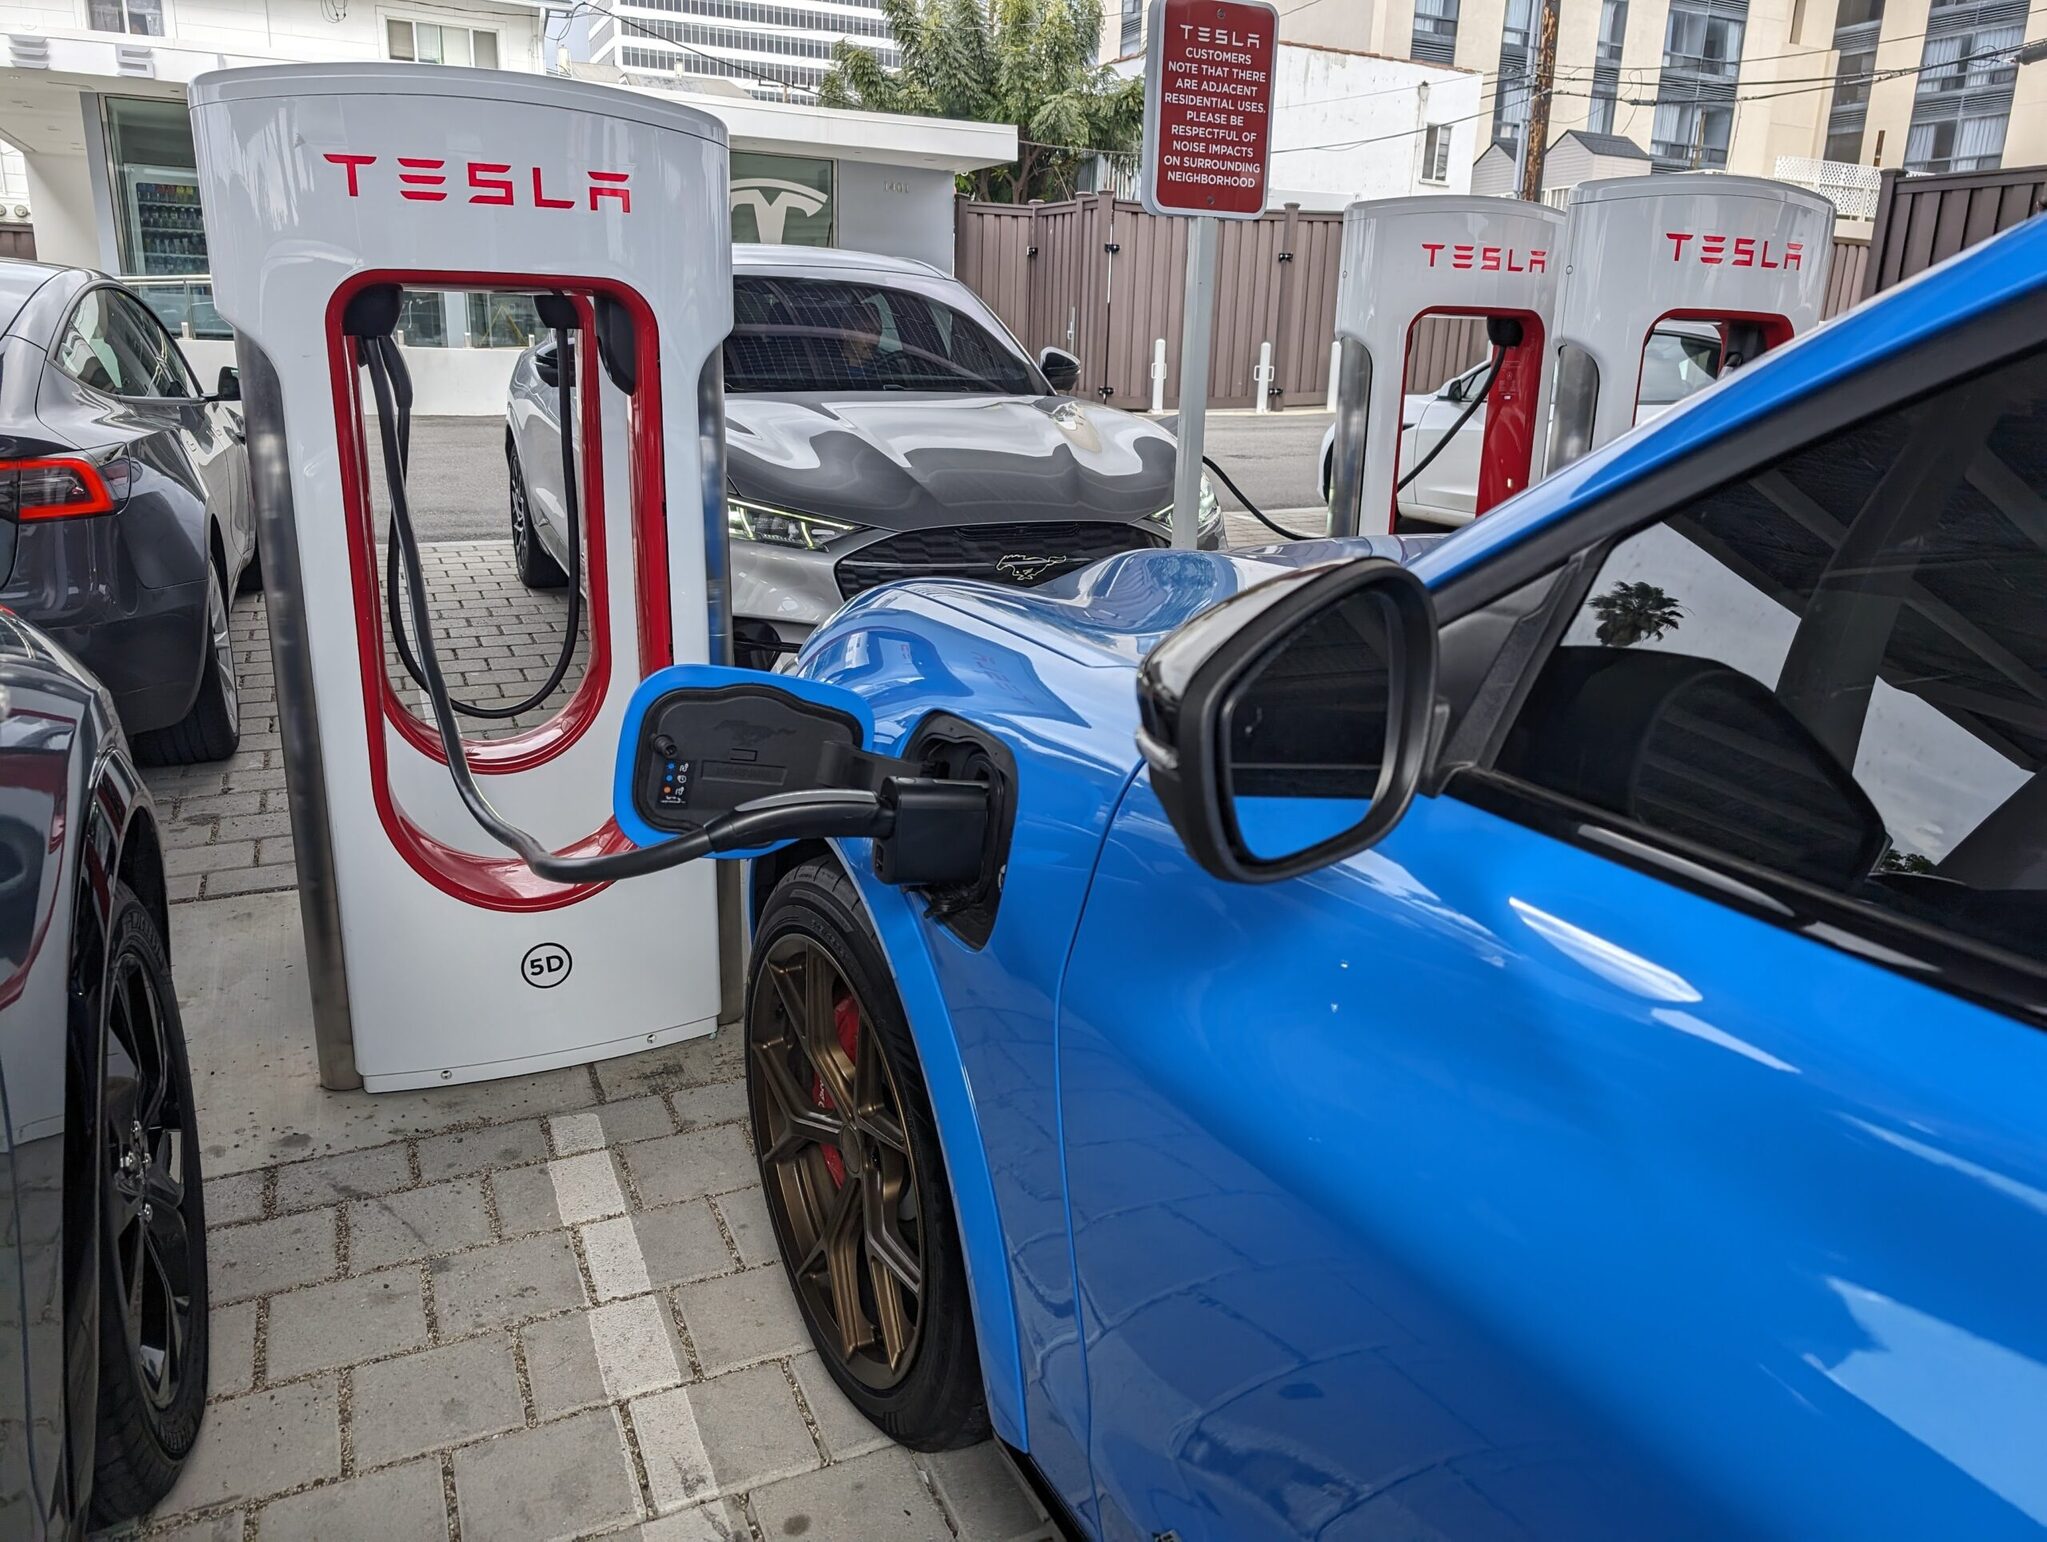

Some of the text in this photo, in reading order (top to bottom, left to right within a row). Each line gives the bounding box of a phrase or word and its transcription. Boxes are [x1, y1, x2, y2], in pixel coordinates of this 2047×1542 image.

[1180, 24, 1260, 48] TESLA
[1185, 47, 1252, 65] CUSTOMERS
[1168, 61, 1266, 82] NOTE THAT THERE
[1175, 78, 1258, 97] ARE ADJACENT
[1164, 92, 1266, 114] RESIDENTIAL USES.
[1186, 110, 1244, 126] PLEASE BE
[1171, 124, 1257, 142] RESPECTFUL OF
[1172, 140, 1254, 158] NOISE IMPACTS
[1163, 155, 1261, 174] ON SURROUNDING
[323, 153, 631, 214] TESLA
[1167, 170, 1256, 188] NEIGHBORHOOD
[1421, 243, 1546, 274] TESLA
[1666, 232, 1804, 271] TESLA
[530, 955, 564, 976] 5D
